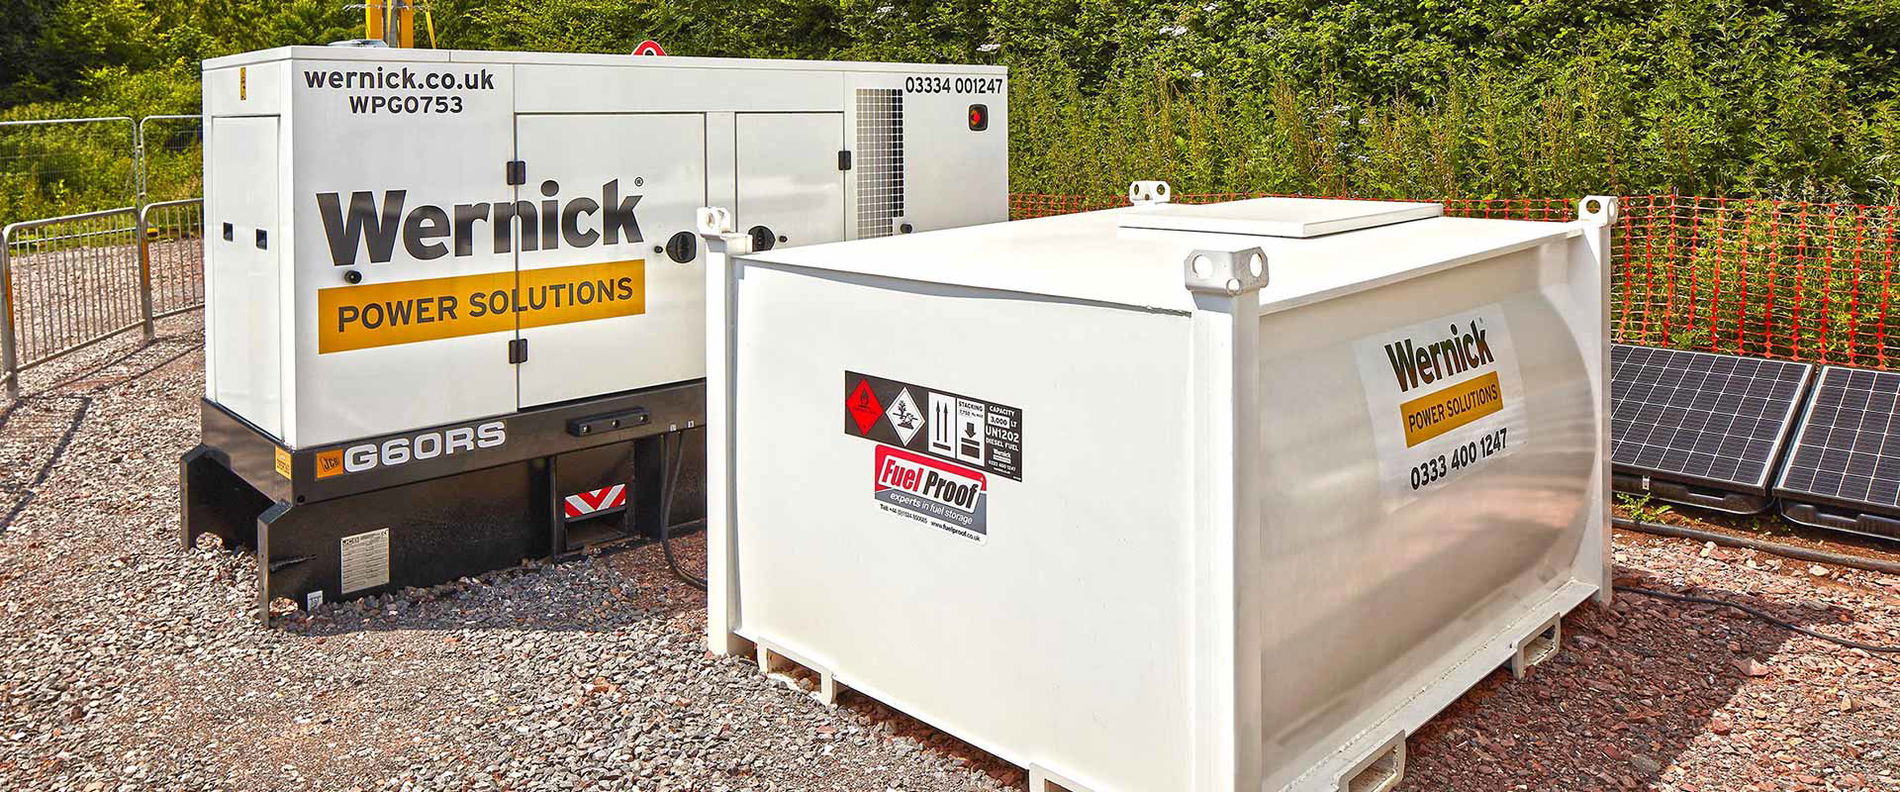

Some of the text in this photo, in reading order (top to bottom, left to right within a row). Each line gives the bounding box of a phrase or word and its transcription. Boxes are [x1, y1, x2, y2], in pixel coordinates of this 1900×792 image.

[304, 66, 494, 90] wernick.co.uk
[905, 76, 1003, 94] 03334 001247
[338, 277, 633, 332] POWER SOLUTIONS
[1384, 320, 1495, 393] Wernick
[958, 401, 983, 411] STACKING
[989, 406, 1015, 417] CAPACITY
[1408, 383, 1499, 433] POWER SOLUTIONS
[985, 425, 1019, 443] UN1202
[990, 416, 1017, 428] 3,000 LT
[344, 421, 506, 472] G60RS
[985, 437, 1019, 452] DIESEL FUEL
[1410, 428, 1507, 490] 0333 400 1247
[882, 458, 979, 509] Fuel Proof
[890, 492, 973, 525] experts in fuel storage
[930, 520, 981, 542] www.fuelproof.co.uk
